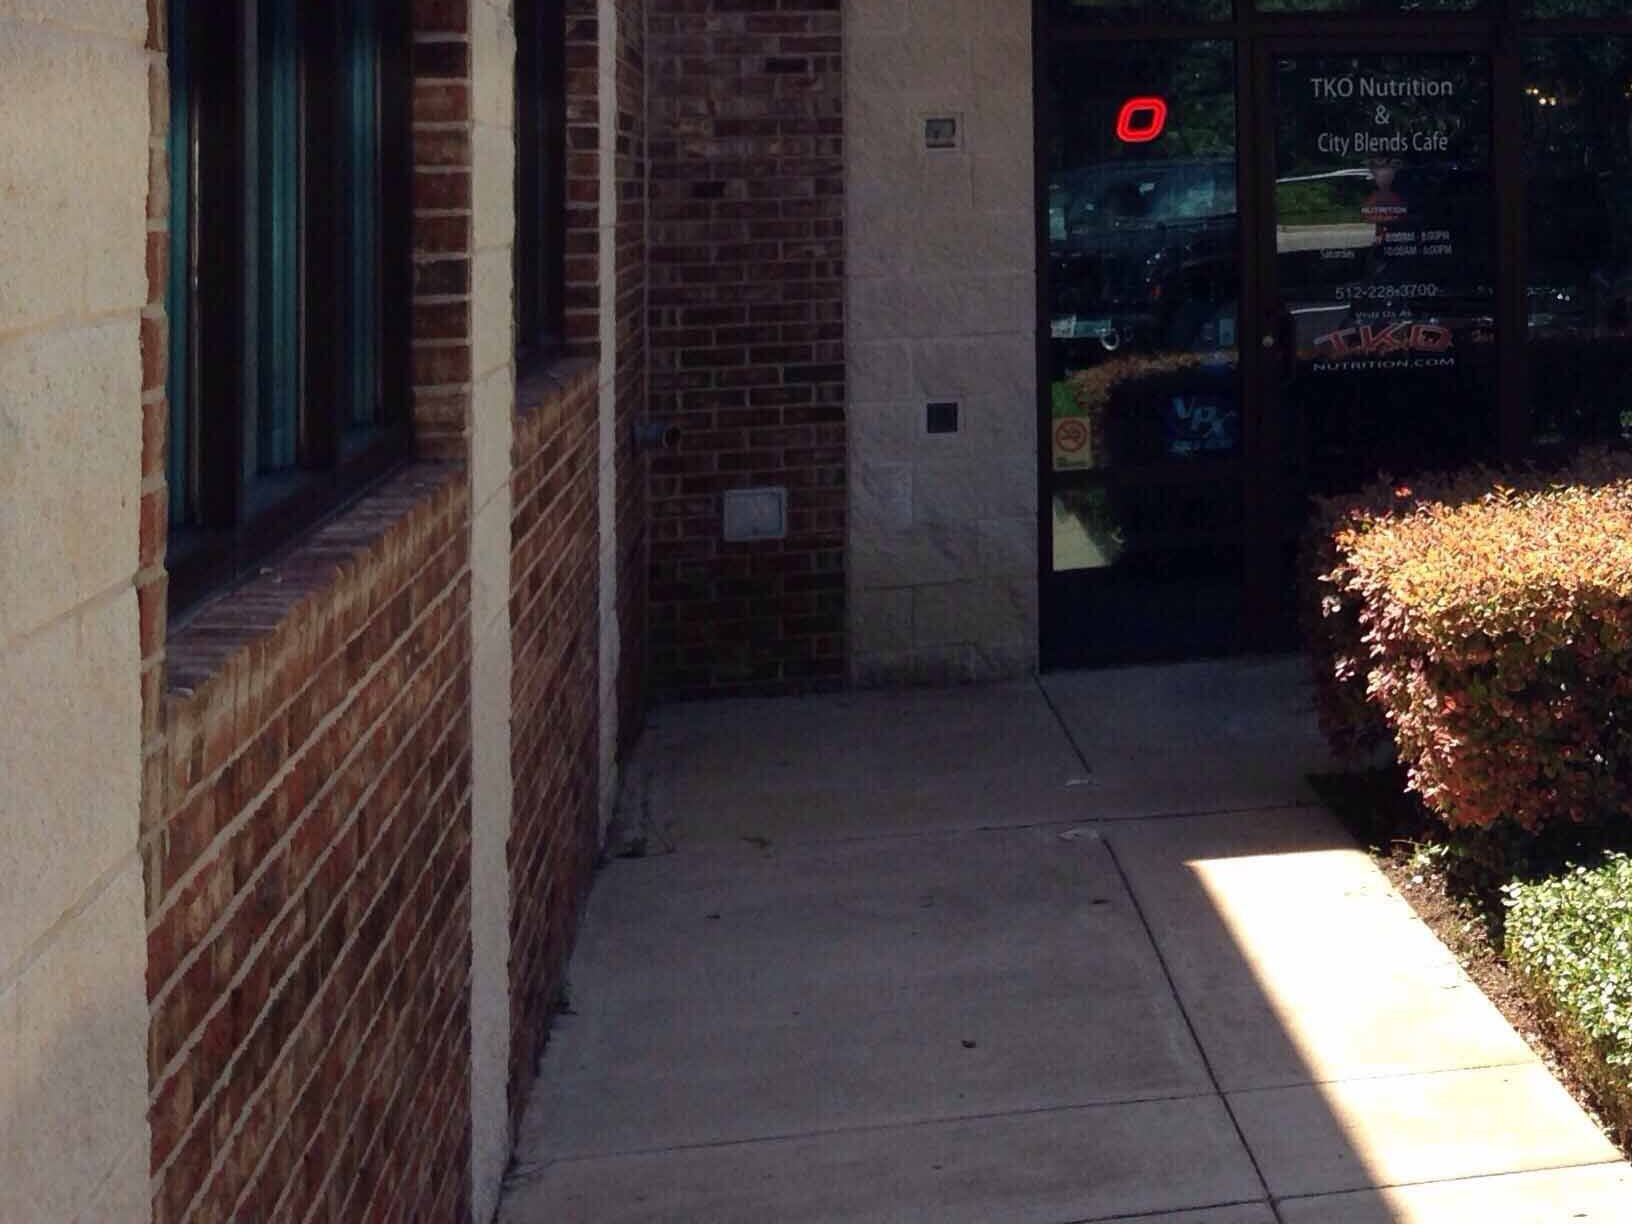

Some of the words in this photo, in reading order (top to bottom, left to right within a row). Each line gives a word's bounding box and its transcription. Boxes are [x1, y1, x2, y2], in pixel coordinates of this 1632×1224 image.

[1311, 77, 1353, 97] TKO
[1359, 77, 1453, 97] Nutrition
[1374, 104, 1391, 125] &
[1317, 132, 1350, 156] City
[1354, 131, 1408, 152] Blends
[1313, 320, 1457, 355] TKO
